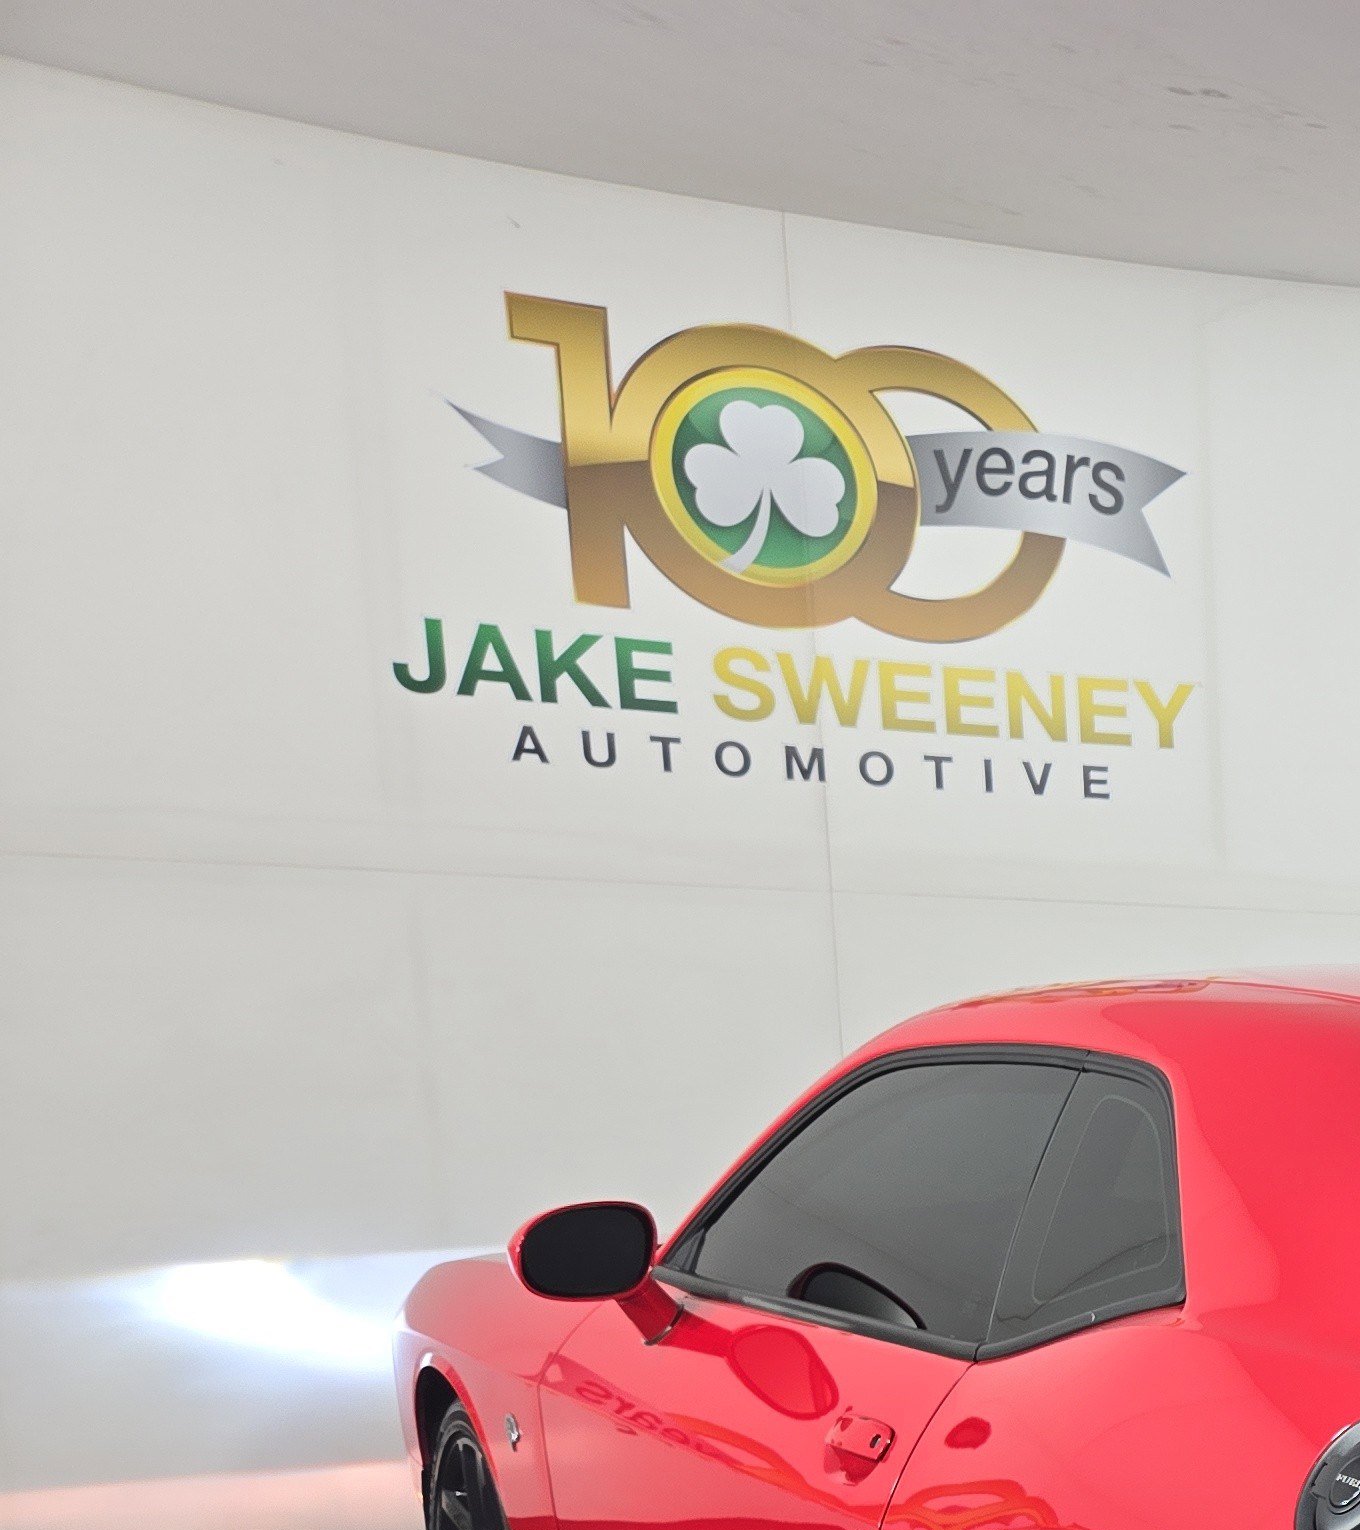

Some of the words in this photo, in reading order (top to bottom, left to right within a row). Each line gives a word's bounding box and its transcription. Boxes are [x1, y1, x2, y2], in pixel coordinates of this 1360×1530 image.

[933, 441, 1128, 517] years
[393, 617, 679, 715] JAKE
[712, 645, 1194, 751] SWEENEY
[511, 724, 1112, 800] AUTOMOTIVE
